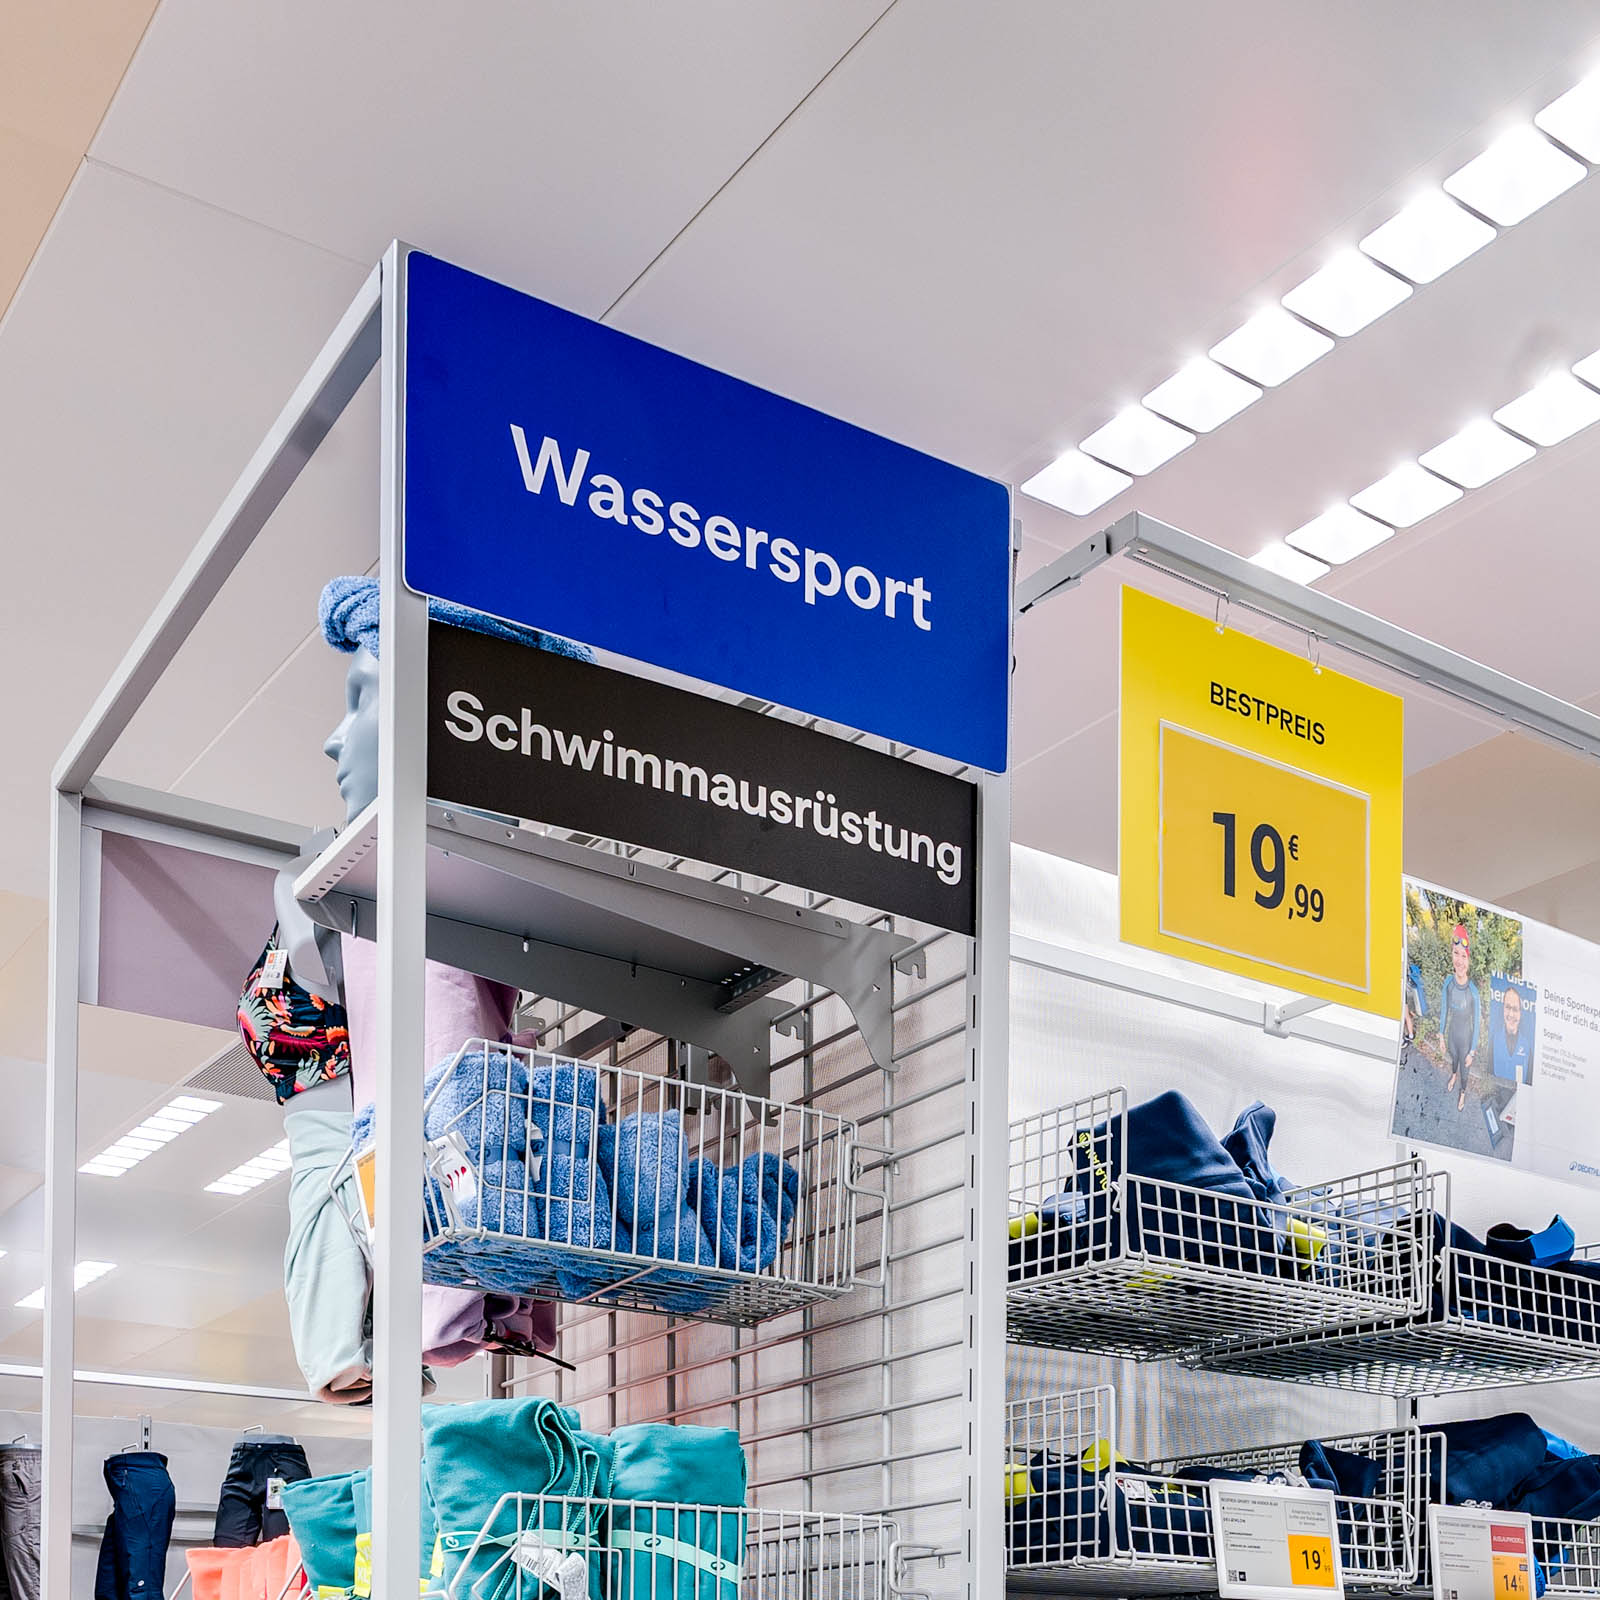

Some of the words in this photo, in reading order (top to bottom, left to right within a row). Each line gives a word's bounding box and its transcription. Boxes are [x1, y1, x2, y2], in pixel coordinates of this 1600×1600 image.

[510, 423, 932, 632] Wassersport
[1211, 681, 1325, 745] BESTPREIS
[445, 690, 962, 885] Schwimmausrüstung
[1544, 989, 1566, 1005] Deine
[1544, 1006, 1560, 1019] sind
[1561, 1010, 1573, 1023] für
[1573, 1013, 1588, 1027] dich
[1590, 1020, 1600, 1032] da.
[1302, 1549, 1321, 1571] 19
[1503, 1574, 1518, 1592] 14
